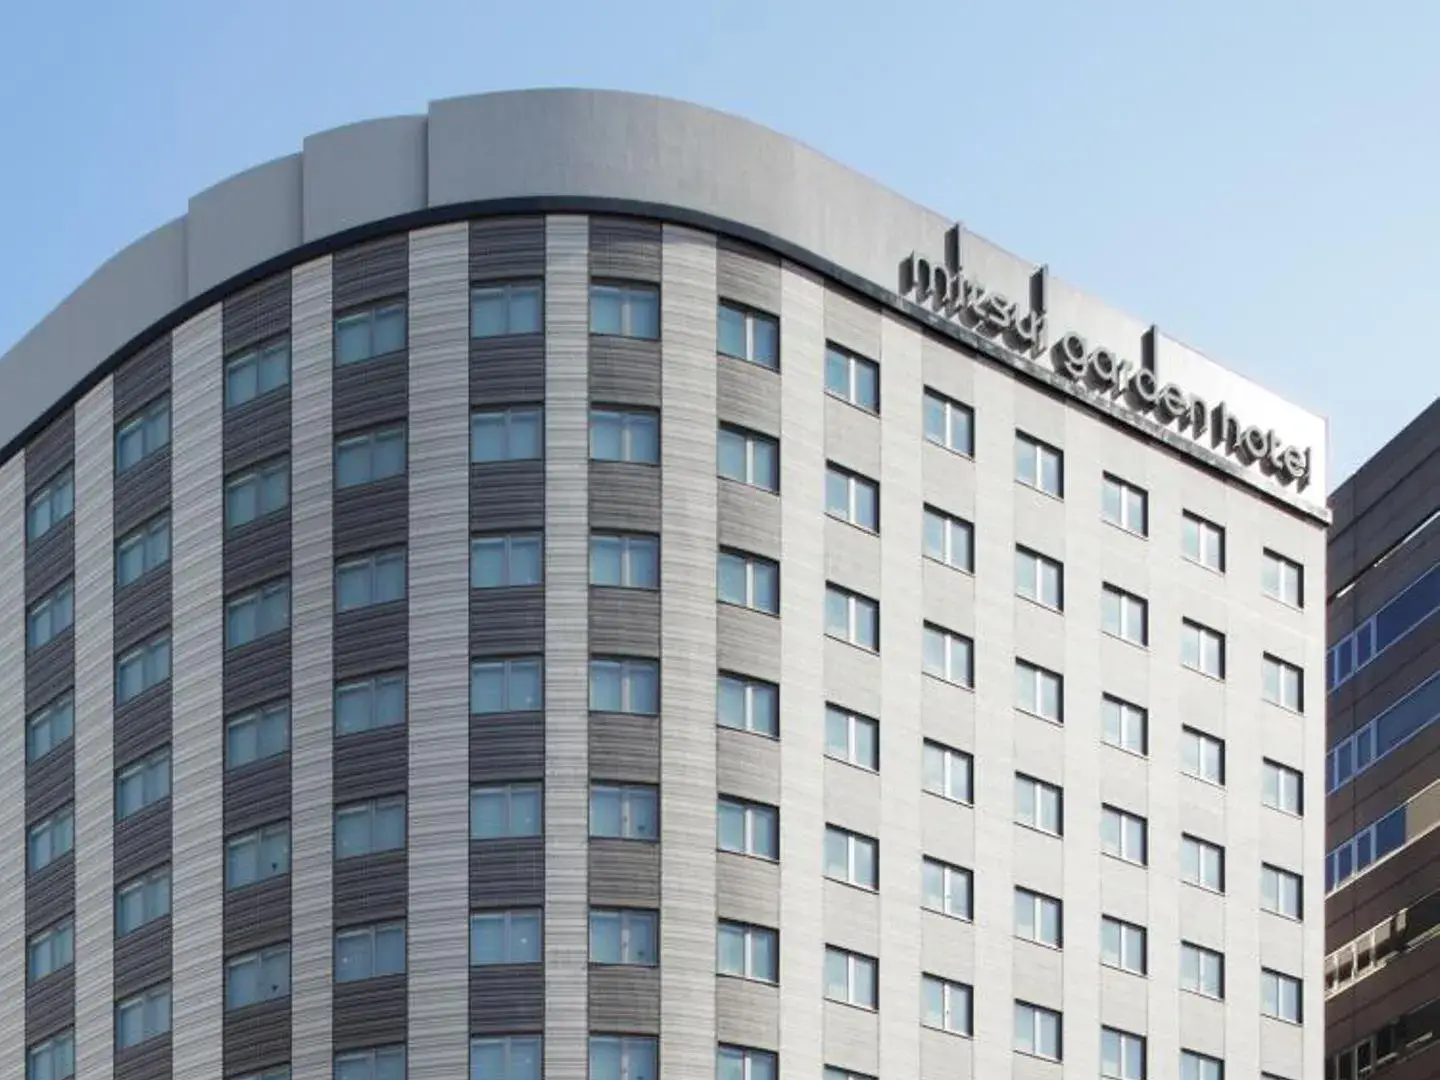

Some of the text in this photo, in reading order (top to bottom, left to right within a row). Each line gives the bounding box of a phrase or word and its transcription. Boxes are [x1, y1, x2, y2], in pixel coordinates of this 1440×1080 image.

[898, 222, 1312, 493] mitsui garden hotel
